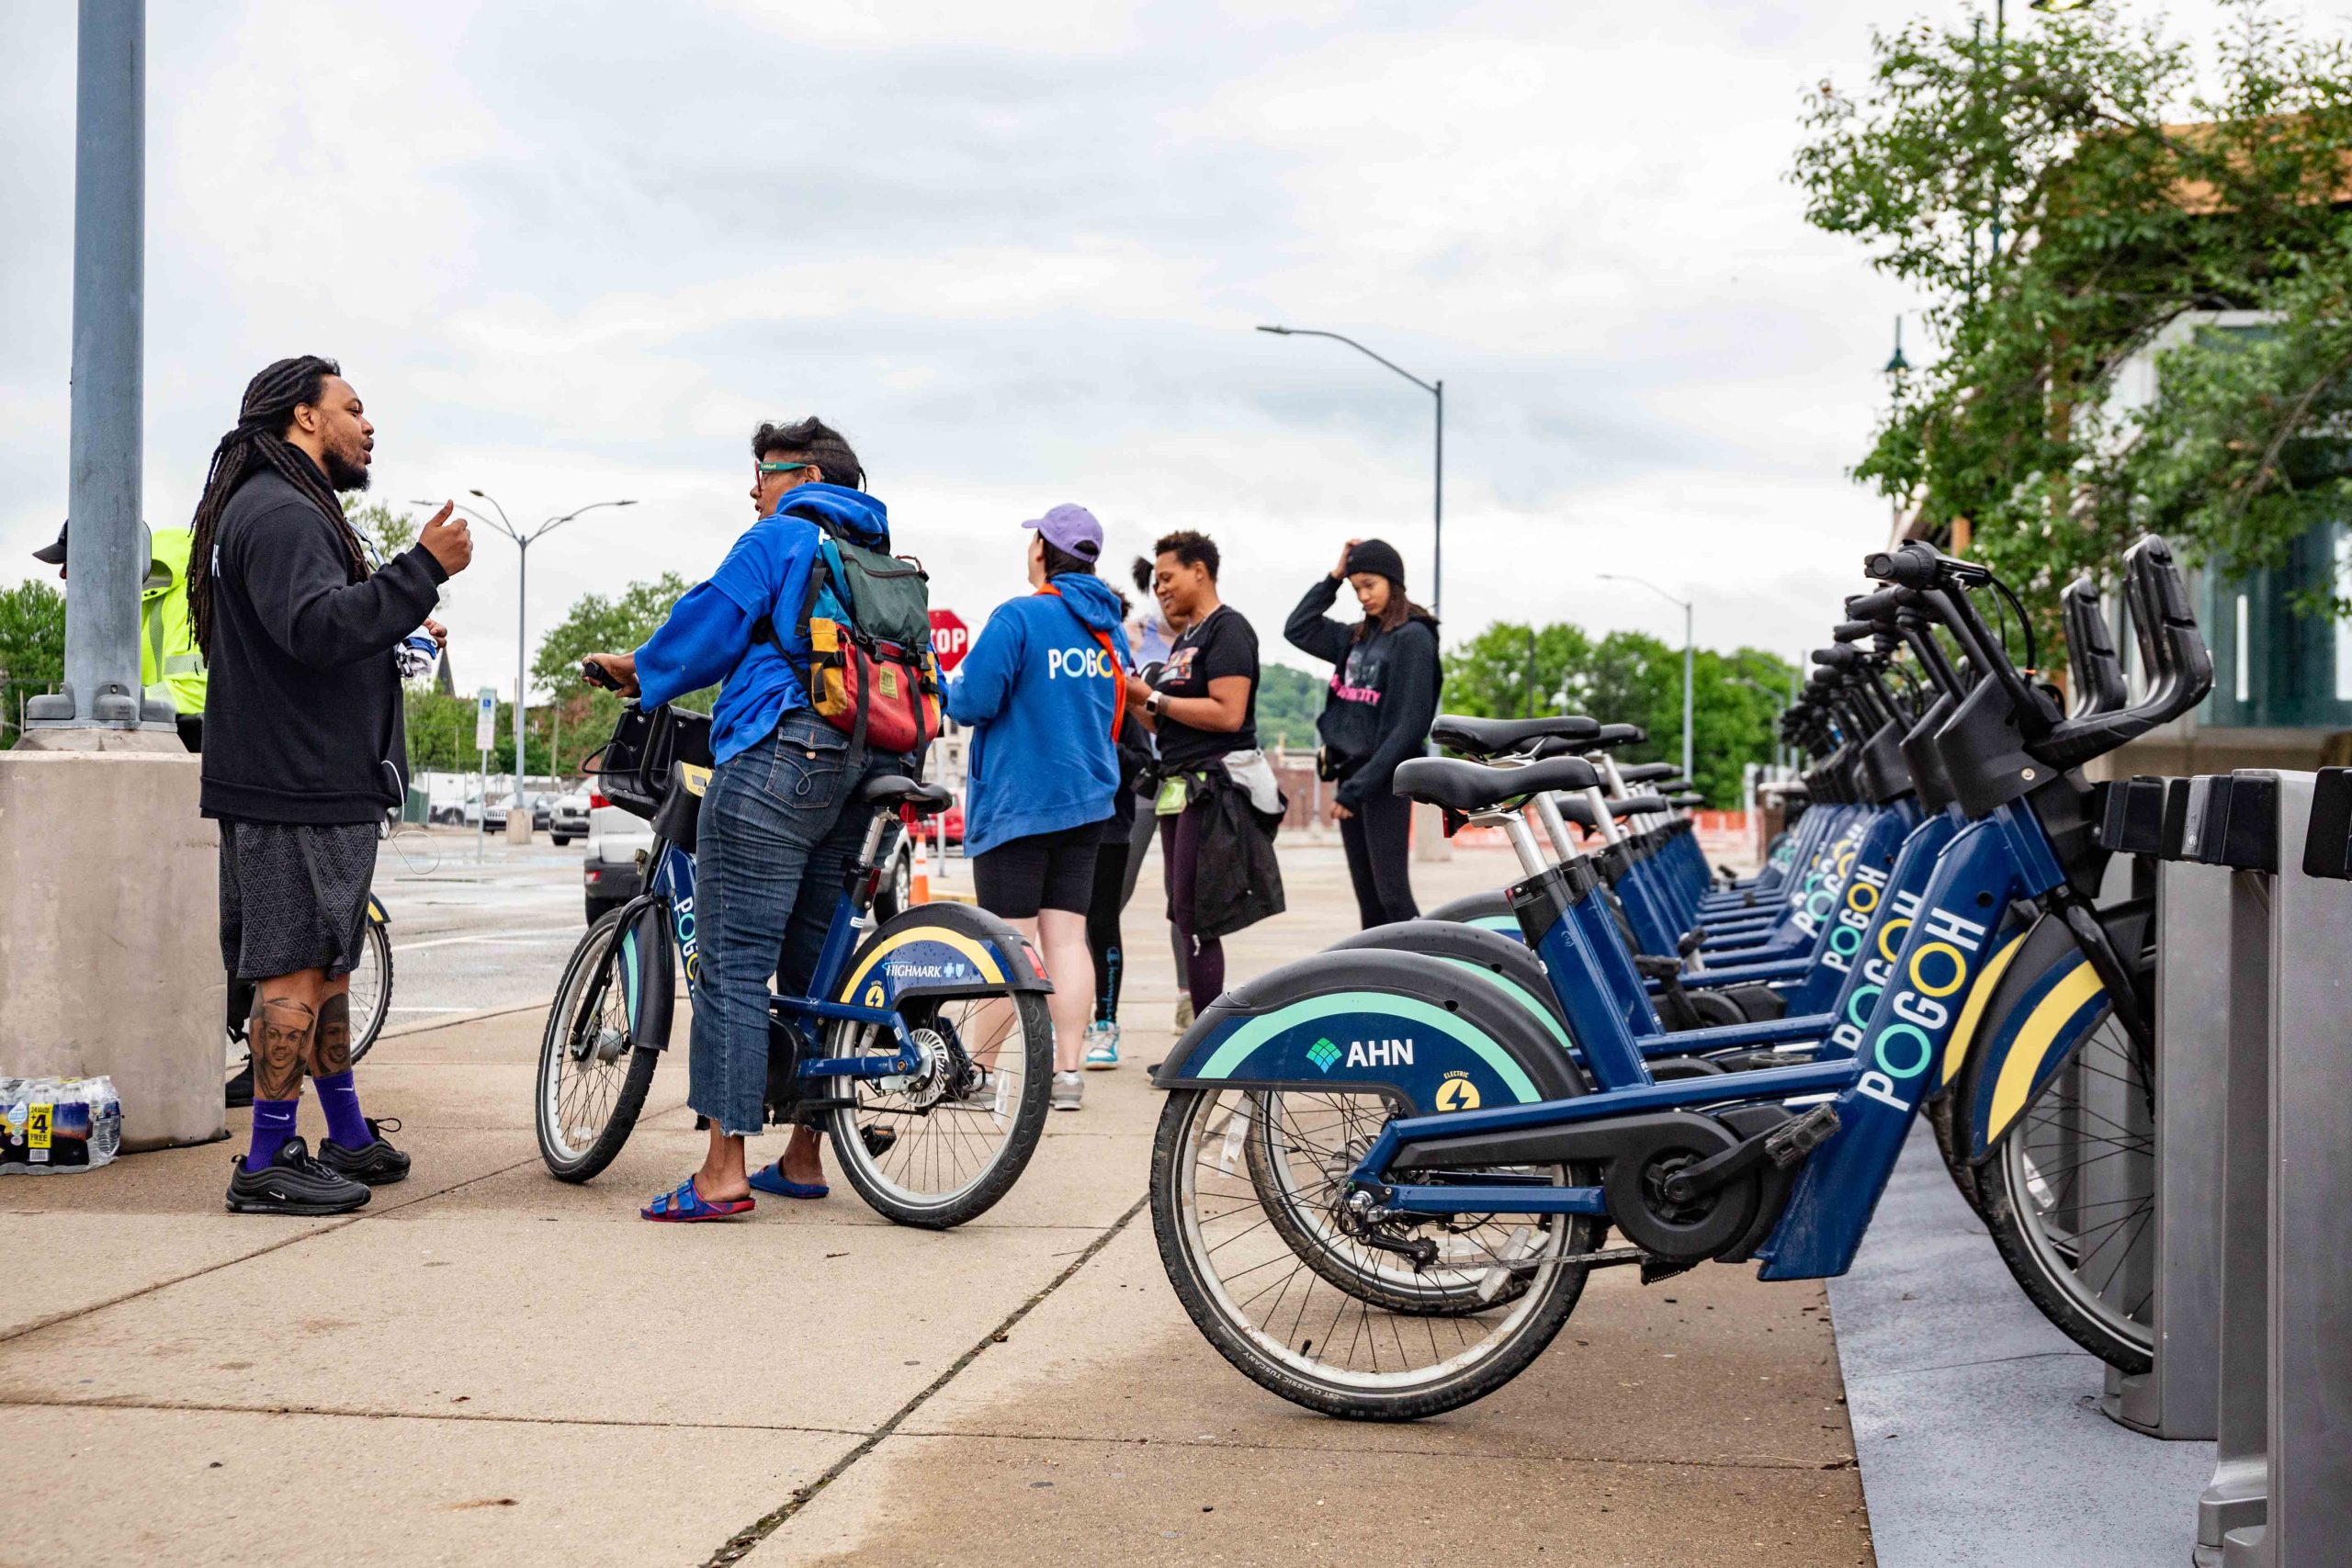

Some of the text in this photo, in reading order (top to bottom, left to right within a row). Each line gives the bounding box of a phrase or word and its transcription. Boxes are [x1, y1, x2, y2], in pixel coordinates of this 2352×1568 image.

[931, 628, 967, 654] OP
[1822, 864, 1889, 974] POGOH
[674, 896, 698, 998] POGO
[885, 964, 943, 978] HIGHMARK
[1856, 907, 1985, 1112] POGOH
[1346, 1038, 1414, 1067] AHN
[1443, 1070, 1469, 1079] ELECTRIC
[30, 1134, 48, 1142] FREE
[1242, 1351, 1282, 1380] TUSCANY
[1283, 1376, 1321, 1395] CLASSIC
